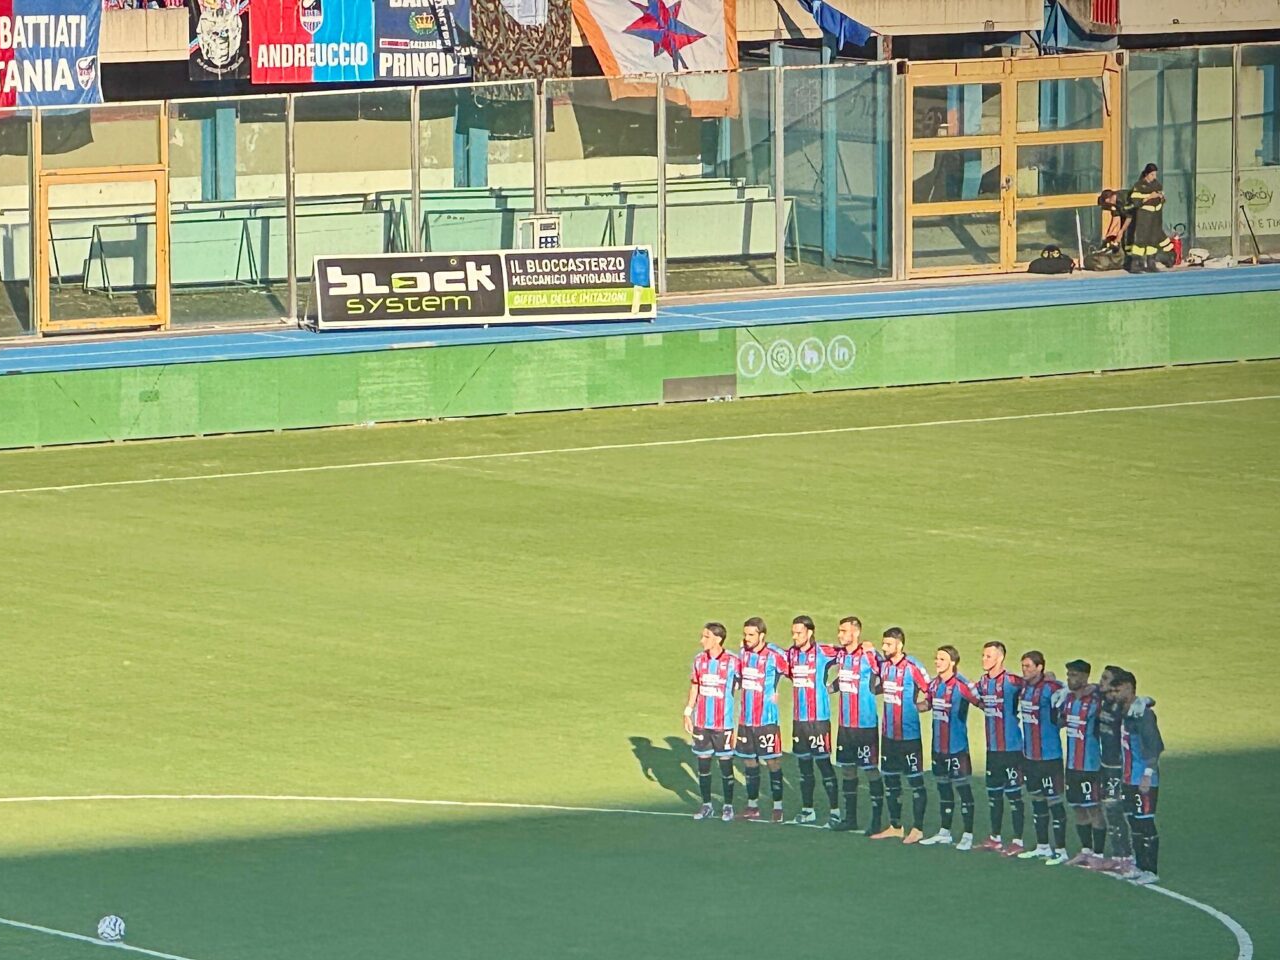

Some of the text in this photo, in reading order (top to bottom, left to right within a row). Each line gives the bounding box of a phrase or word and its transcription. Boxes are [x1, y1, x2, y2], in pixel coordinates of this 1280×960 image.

[257, 42, 368, 68] ANDREUCCIO
[510, 257, 625, 273] IL BLOCCASTERZO
[512, 272, 626, 286] MECCANICO INVIOLABILE
[346, 295, 472, 315] system
[758, 733, 776, 749] 32
[808, 733, 825, 749] 24
[905, 752, 918, 767] 15
[945, 757, 961, 770] 73
[1005, 767, 1018, 780] 16
[1080, 781, 1092, 794] 10
[1134, 793, 1143, 807] 3
